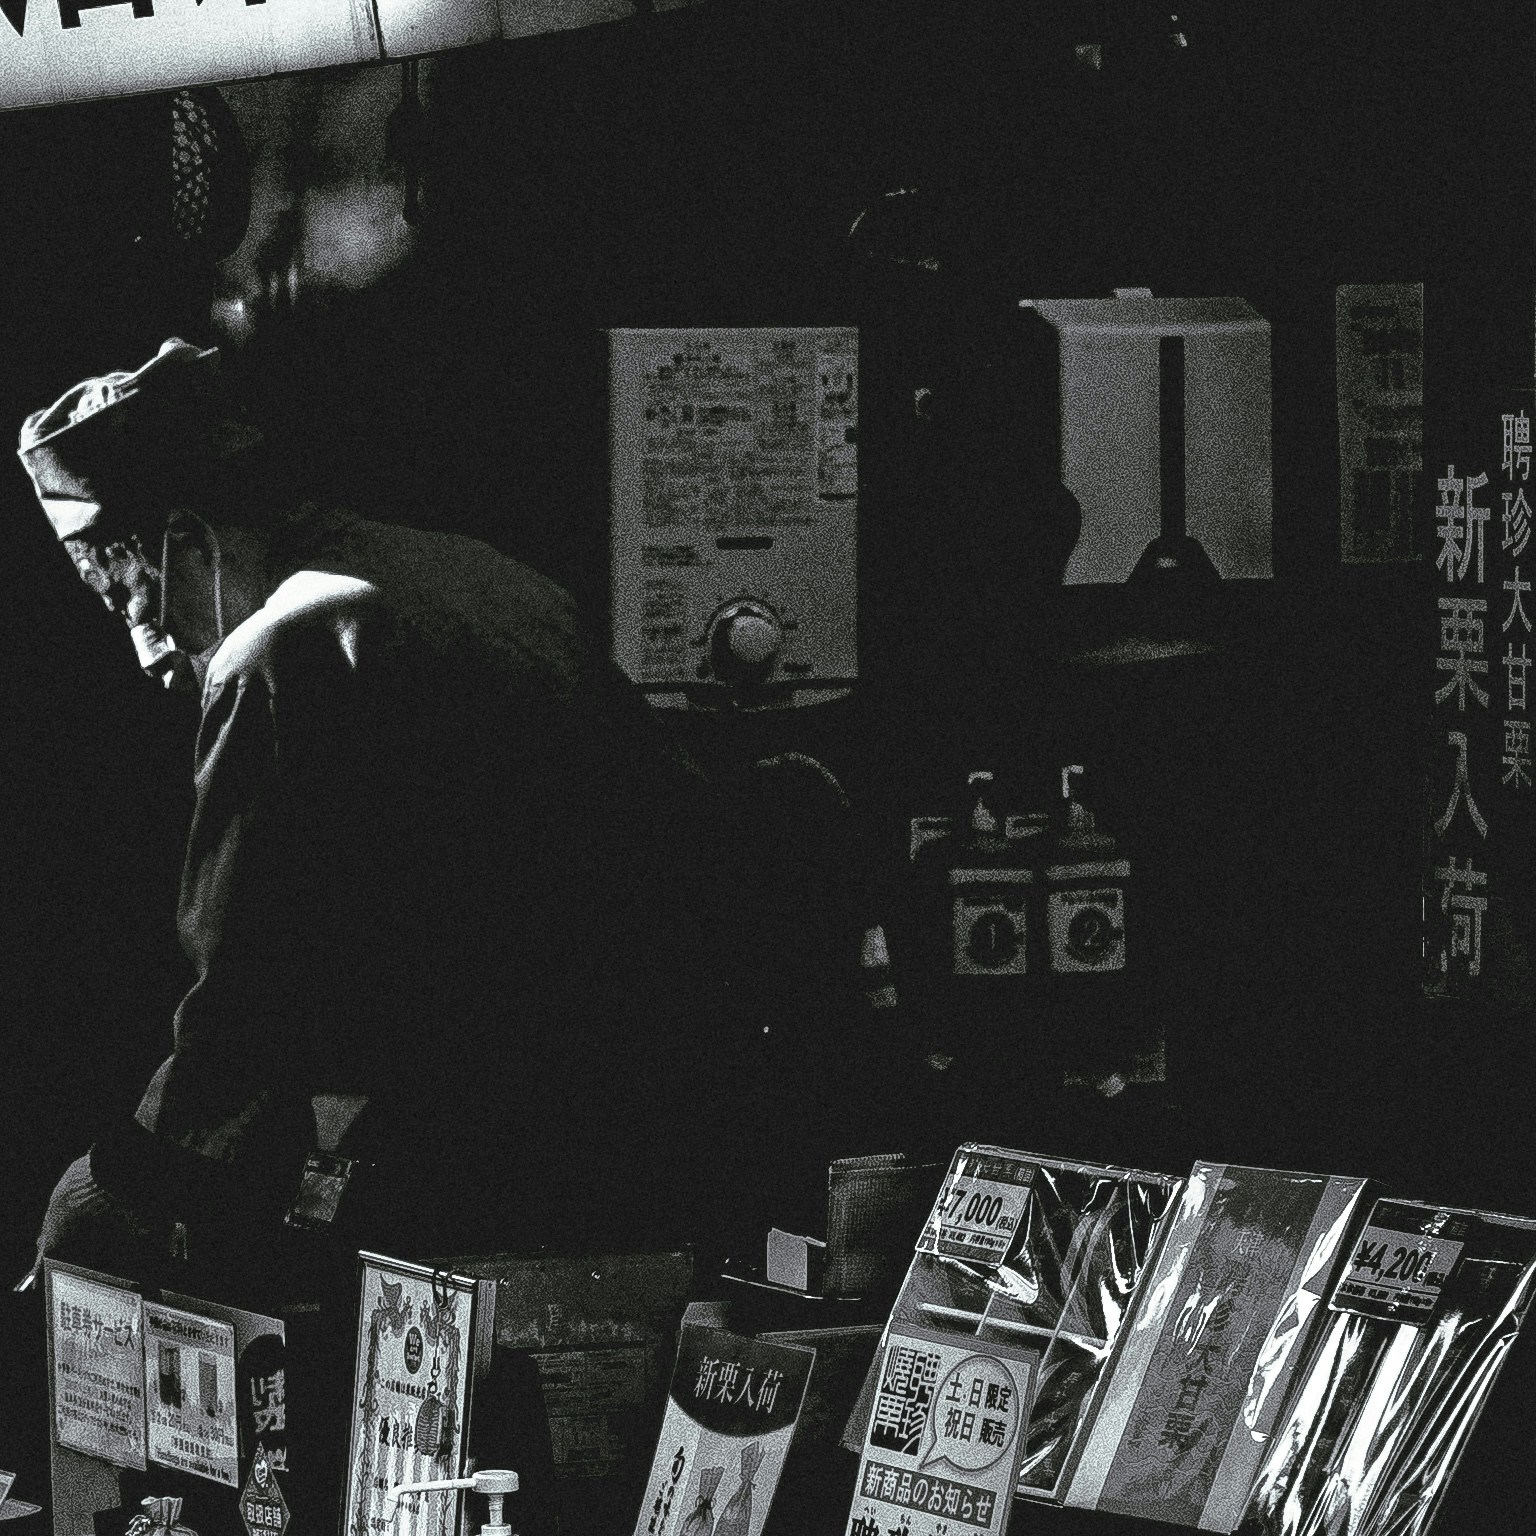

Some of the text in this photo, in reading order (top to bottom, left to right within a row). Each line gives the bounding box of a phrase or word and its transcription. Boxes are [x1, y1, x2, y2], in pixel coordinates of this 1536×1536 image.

[1501, 409, 1534, 789] 聘珍大甘栗
[1435, 465, 1490, 978] 新栗入荷
[1353, 1239, 1435, 1283] ¥4,200
[693, 1355, 783, 1414] 新栗入荷
[985, 1382, 1012, 1413] 限定
[944, 1407, 1006, 1448] 祝日 販売
[865, 1465, 992, 1524] 新商品のお知らせ
